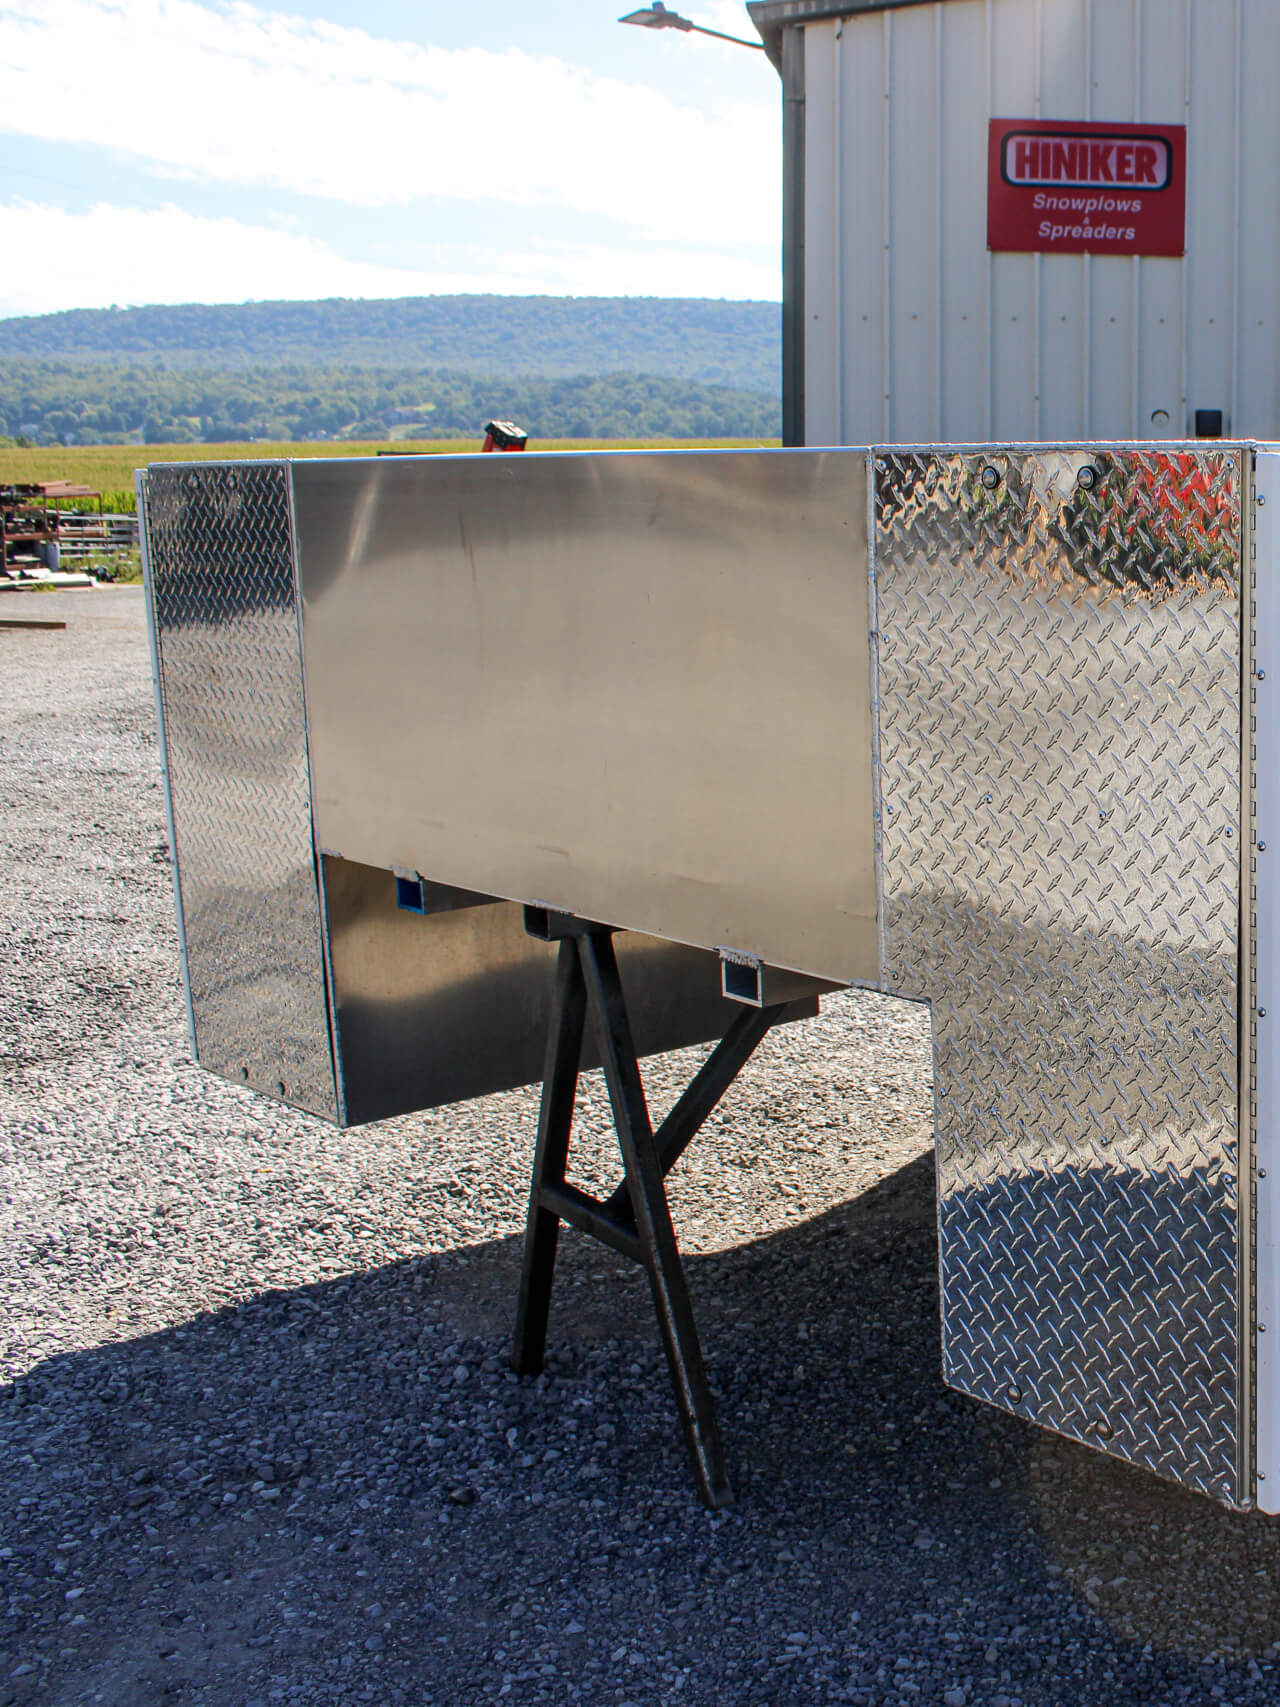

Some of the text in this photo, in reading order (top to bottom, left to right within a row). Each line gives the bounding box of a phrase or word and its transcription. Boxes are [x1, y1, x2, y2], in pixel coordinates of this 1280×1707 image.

[1015, 141, 1158, 184] HINIKER
[1032, 193, 1143, 214] Snowplows
[1038, 221, 1136, 241] Spreaders
